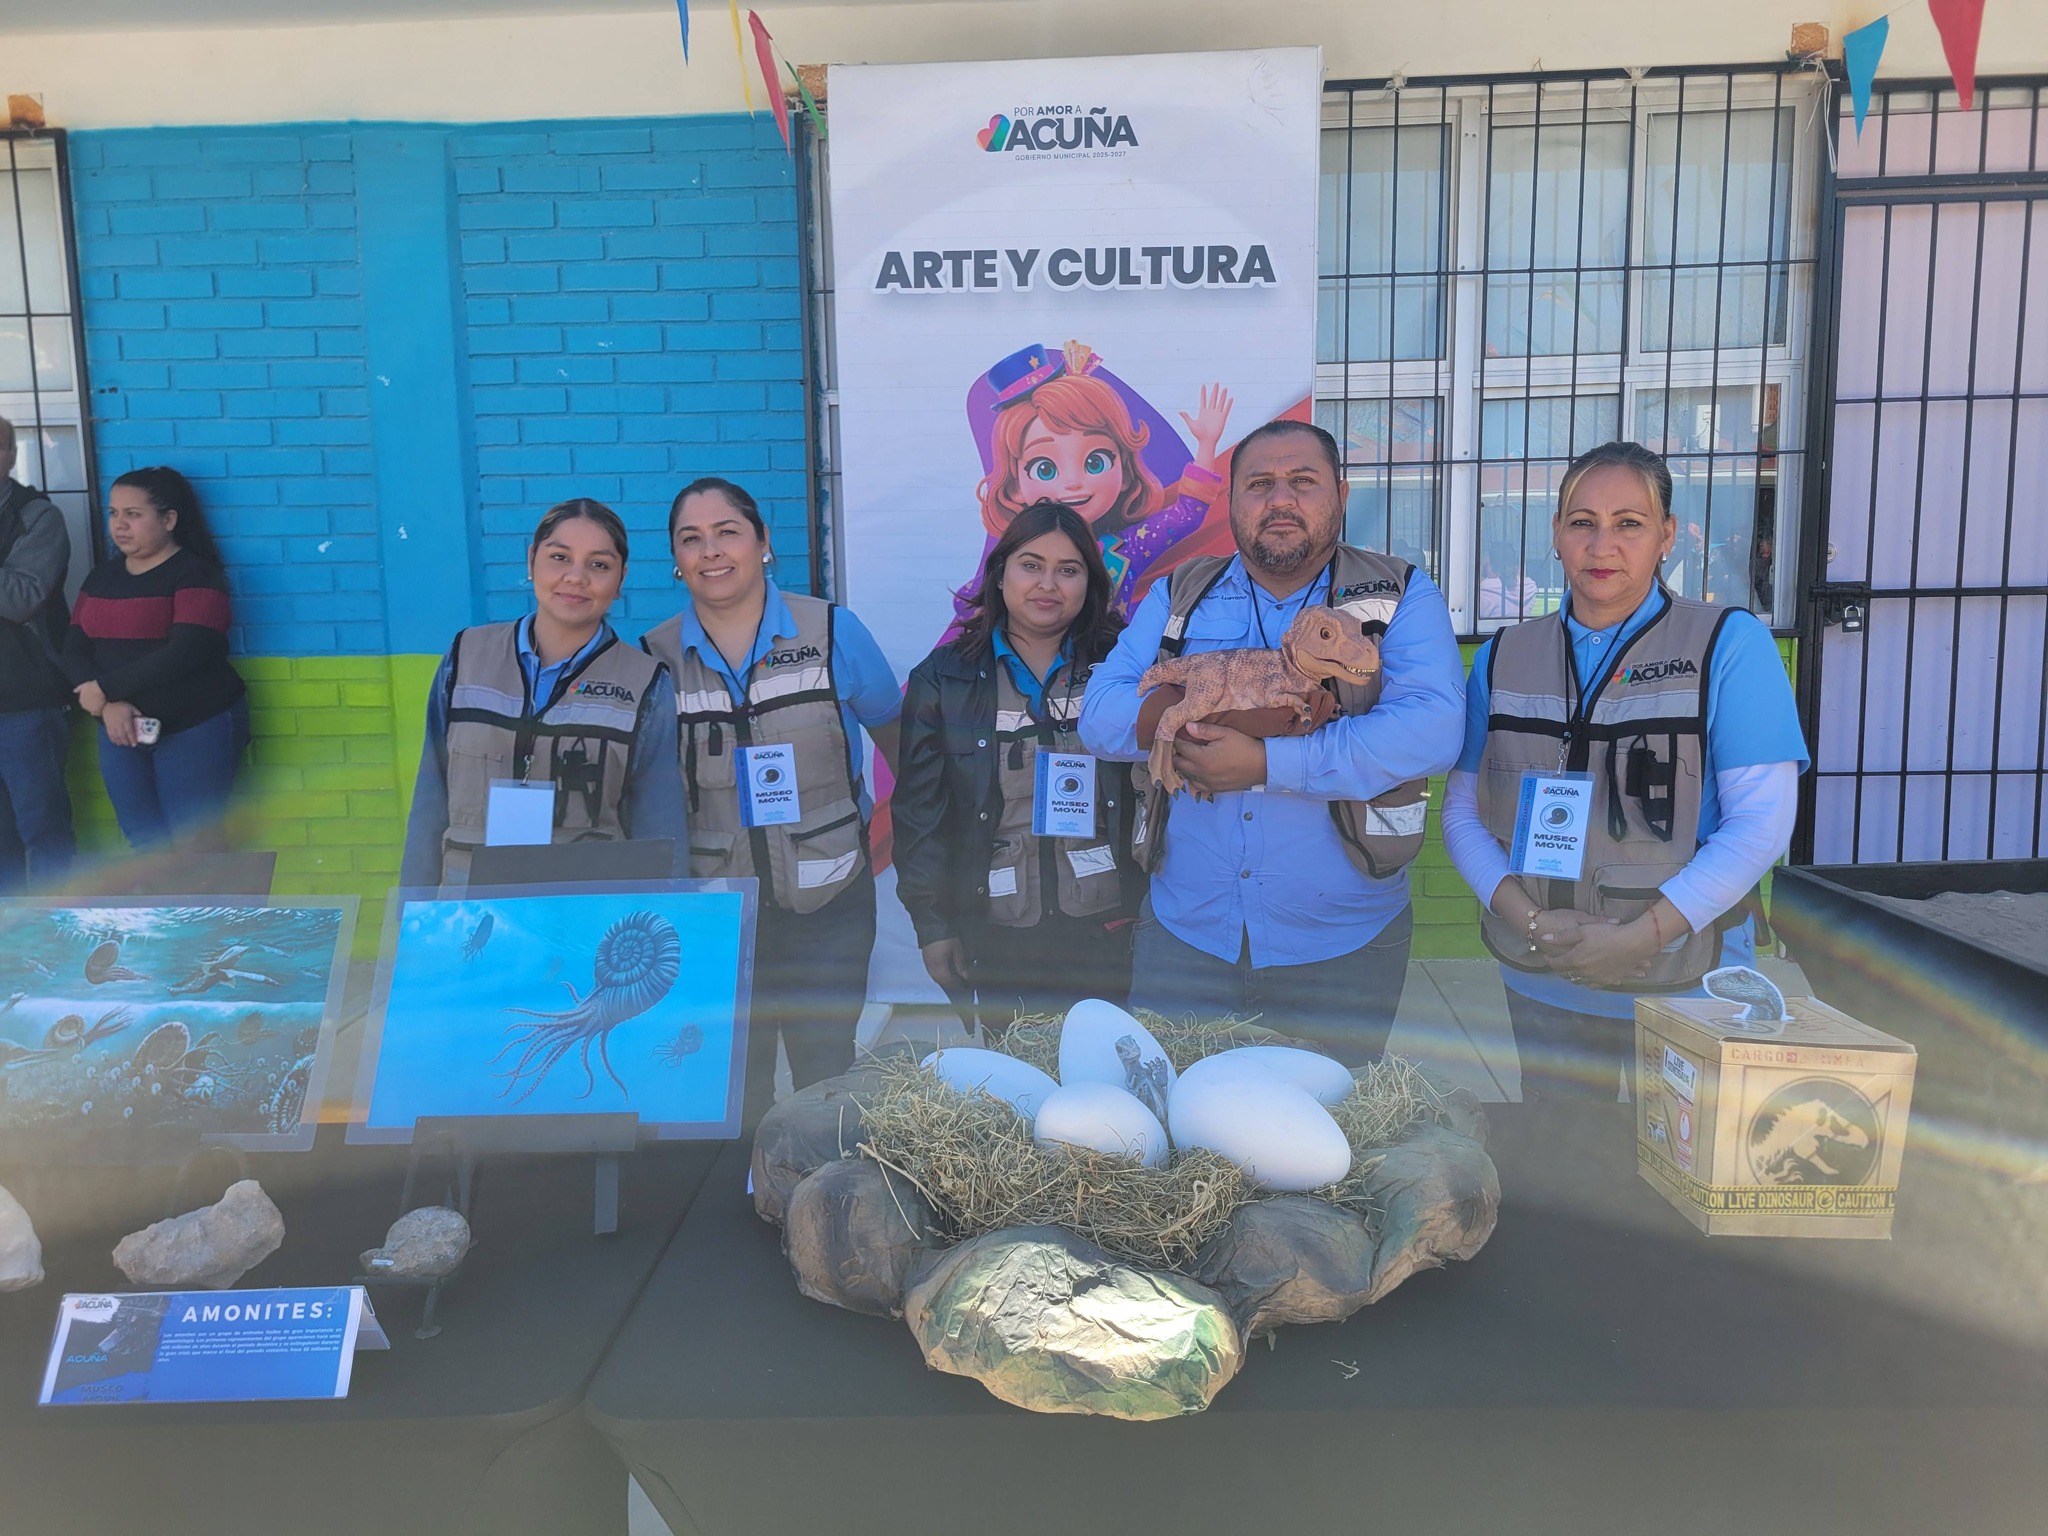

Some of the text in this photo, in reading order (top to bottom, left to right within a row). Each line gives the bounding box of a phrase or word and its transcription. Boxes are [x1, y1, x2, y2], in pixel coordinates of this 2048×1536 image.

[1014, 104, 1082, 116] POR AMOR A
[1004, 106, 1139, 151] ACUÑA
[876, 244, 1277, 289] ARTE Y CULTURA
[1342, 580, 1400, 598] ACUÑA
[771, 644, 822, 668] ACUÑA
[1628, 657, 1698, 683] ACUÑA
[582, 684, 635, 702] ACUÑA
[1060, 760, 1086, 768] ACUÑA
[756, 790, 792, 798] MUSEO
[1549, 788, 1580, 797] ACUÑA
[1534, 834, 1578, 842] MUSEO
[1535, 842, 1574, 850] MOVIL
[1728, 1192, 1755, 1208] LIVE
[1758, 1192, 1814, 1208] DINOSAUR
[1838, 1192, 1885, 1208] CAUTION
[82, 1298, 112, 1309] ACUÑA
[182, 1302, 333, 1322] AMONITES:
[66, 1352, 108, 1363] ACUÑA
